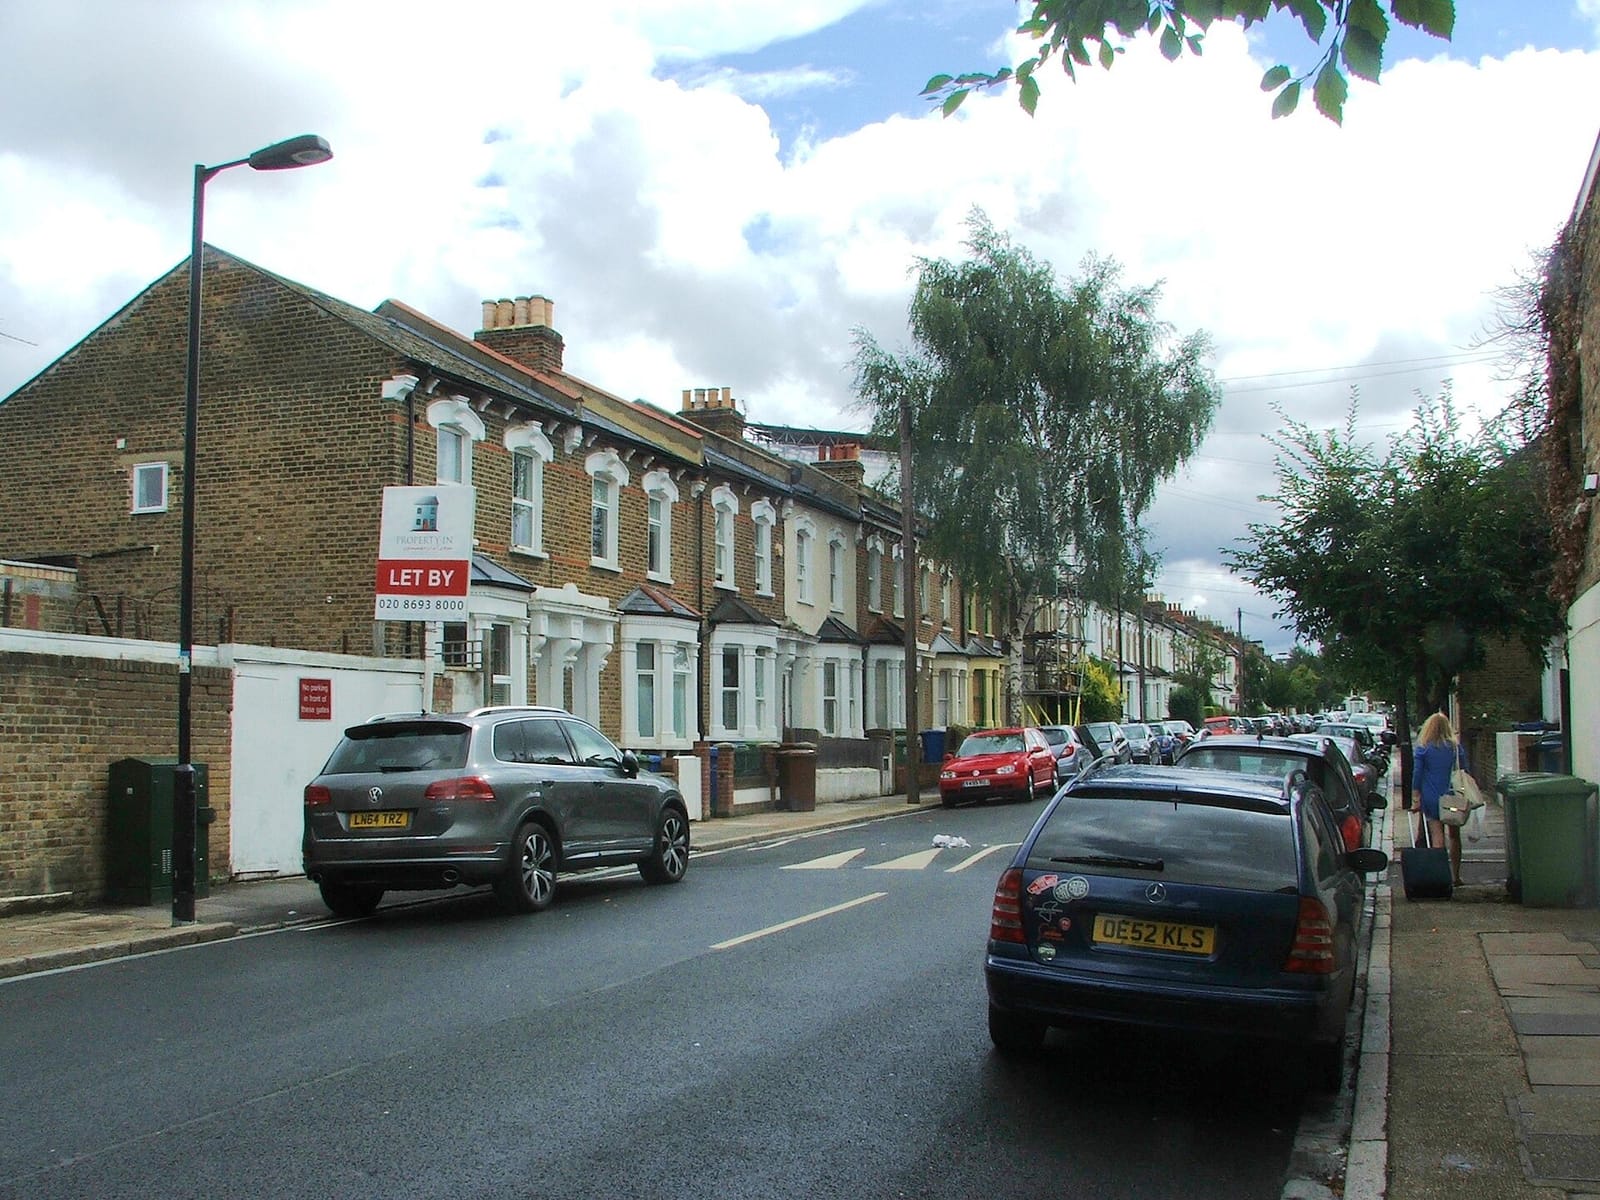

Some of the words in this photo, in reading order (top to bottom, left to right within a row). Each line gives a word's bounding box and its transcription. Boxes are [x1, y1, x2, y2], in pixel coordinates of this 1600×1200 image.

[396, 535, 439, 545] PROPERTY
[389, 568, 424, 587] LET
[428, 569, 455, 588] BY
[379, 599, 400, 609] 020
[403, 599, 431, 610] 8693
[435, 600, 464, 611] 8000
[310, 684, 329, 693] parking
[382, 813, 403, 824] TRZ
[1103, 918, 1156, 943] OE52
[1163, 925, 1205, 948] KLS
